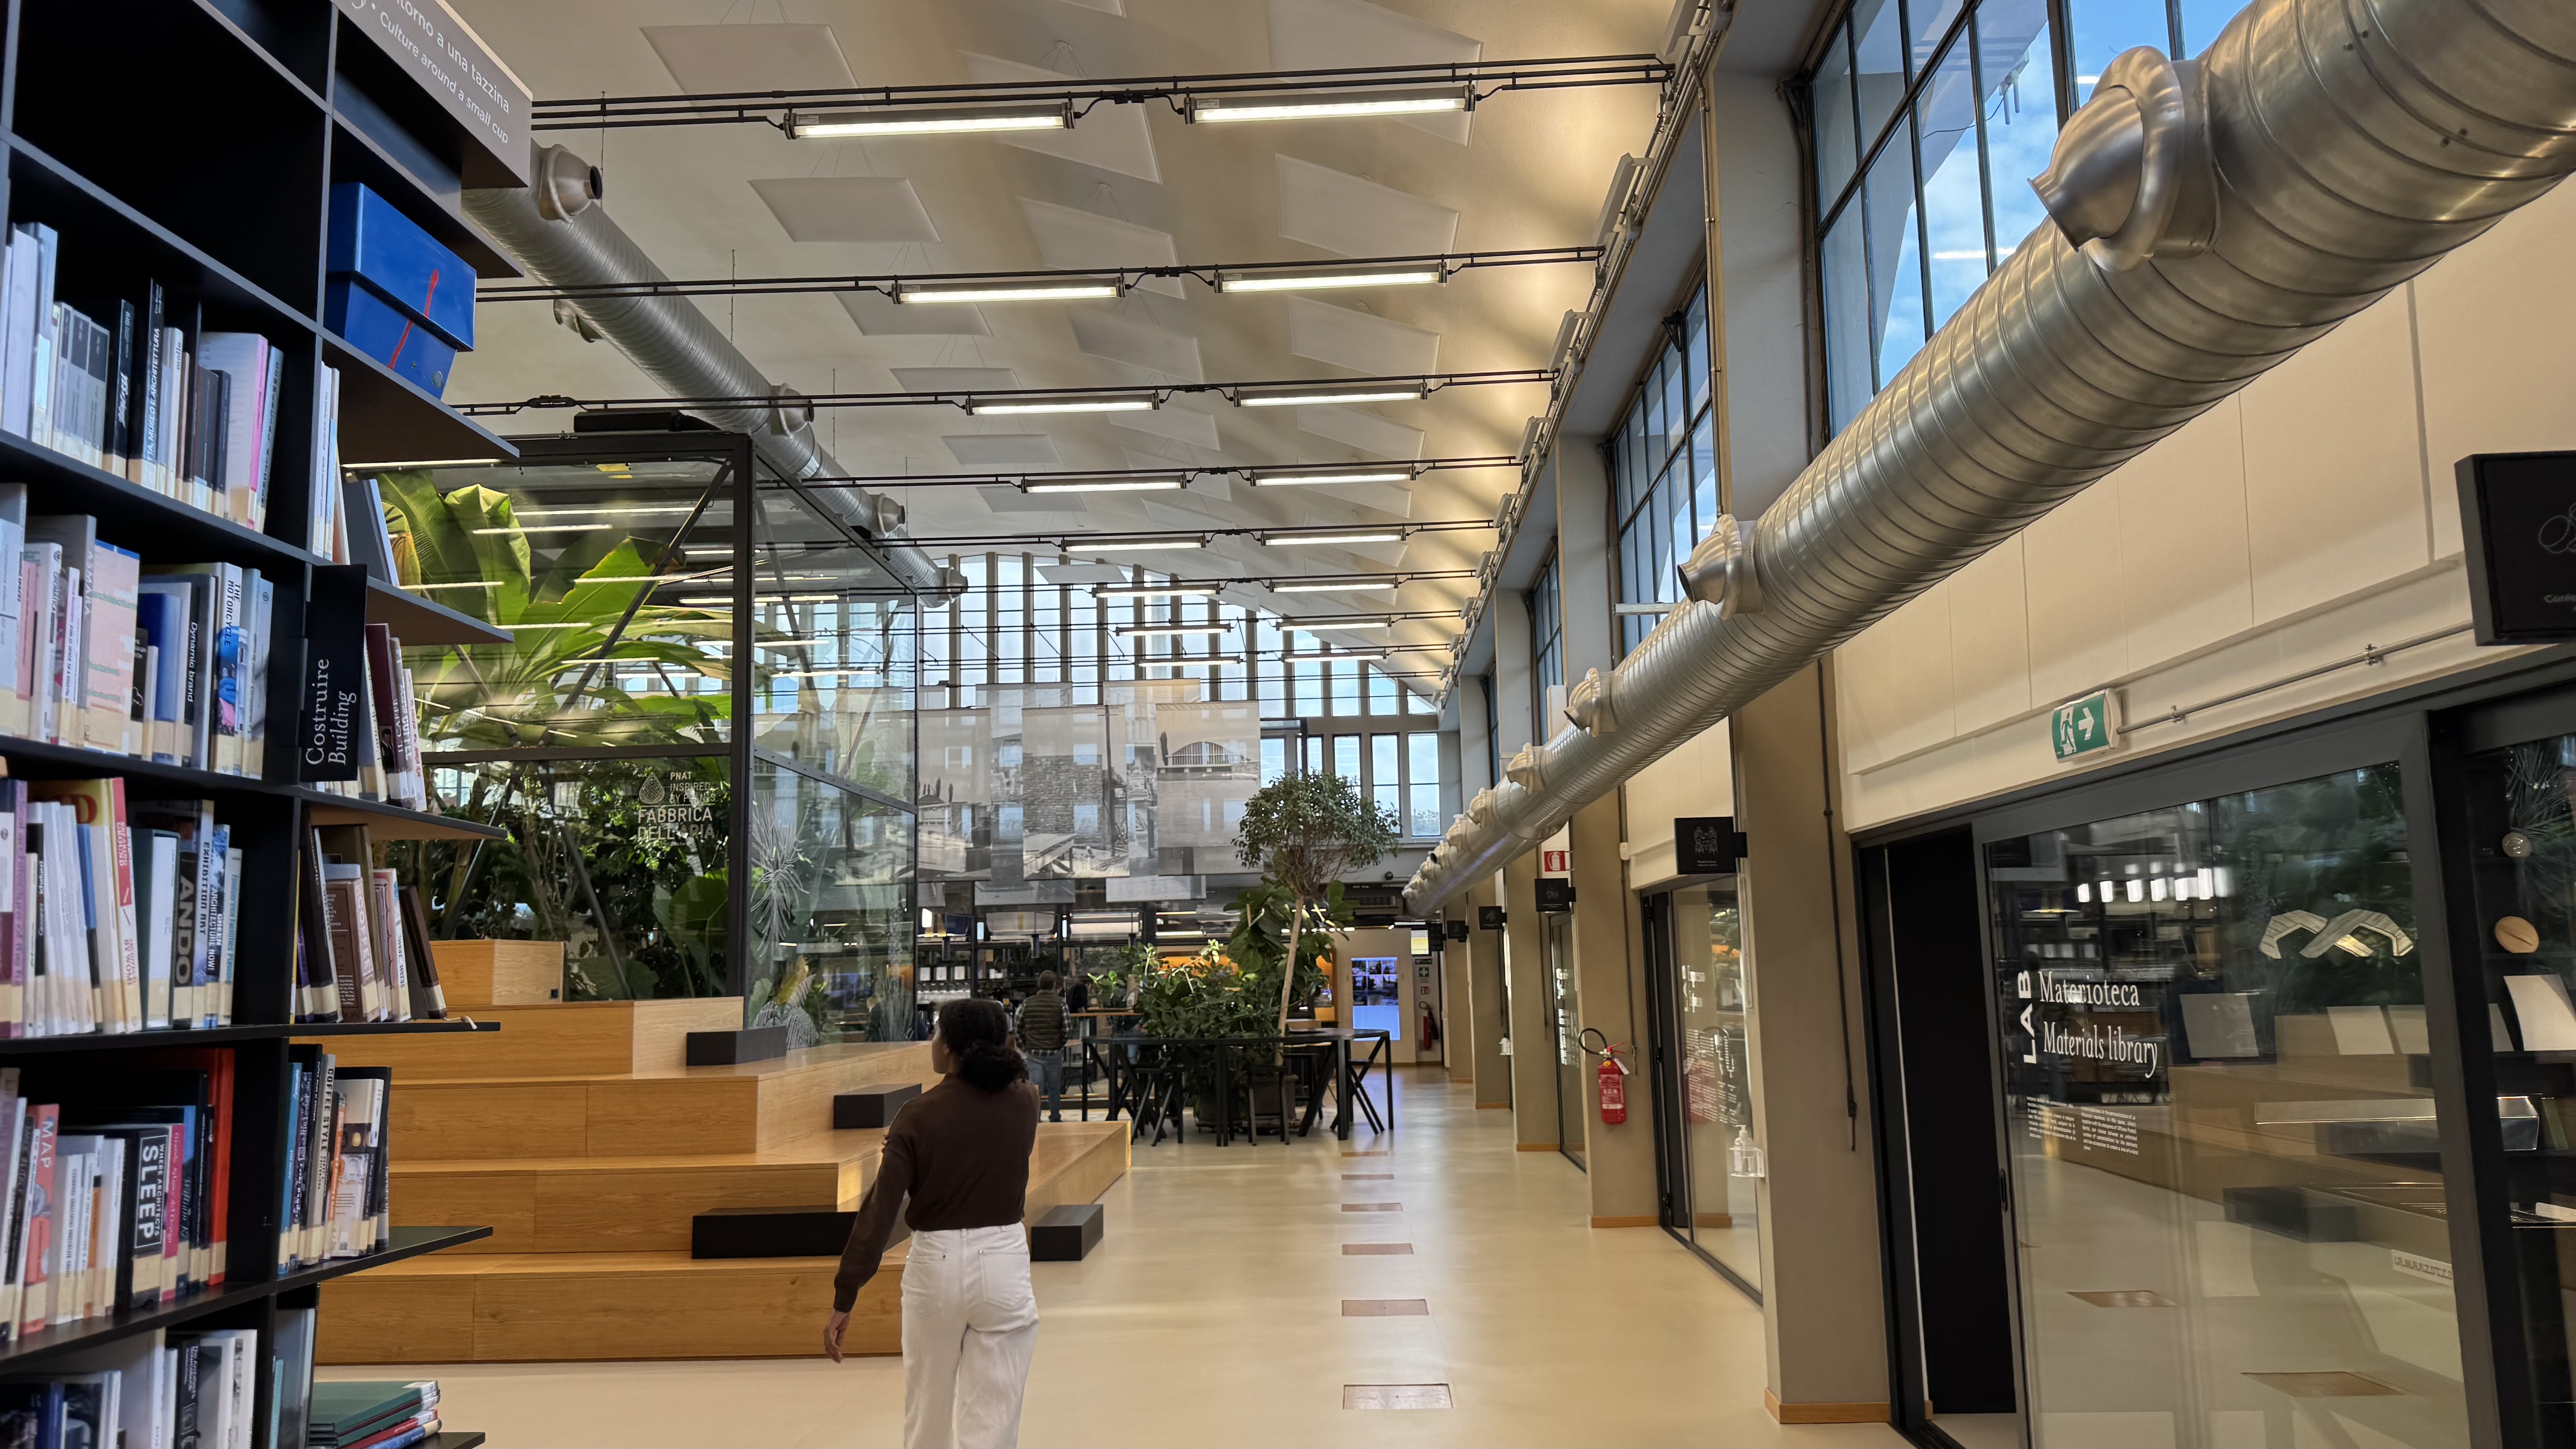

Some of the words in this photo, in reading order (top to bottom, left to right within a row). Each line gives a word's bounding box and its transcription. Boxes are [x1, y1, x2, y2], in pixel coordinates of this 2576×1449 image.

[380, 11, 419, 57] Culture
[421, 53, 456, 94] around
[459, 89, 464, 101] a
[466, 98, 491, 127] small
[492, 122, 509, 144] cup
[437, 32, 444, 48] a
[448, 41, 468, 73] una
[472, 64, 510, 114] tazzina
[151, 328, 160, 400] ARCHITETTURA
[188, 622, 198, 667] Dynamic
[224, 580, 235, 648] MOTORCYCLE
[306, 658, 329, 765] Costruire
[328, 690, 357, 765] Building
[670, 772, 692, 780] PNAT
[670, 782, 710, 791] INSPIRED
[638, 807, 713, 823] FABBRICA
[201, 842, 210, 909] EXHIBITION
[176, 875, 194, 984] ANDO
[208, 888, 219, 947] ARCHITECTURE
[358, 896, 373, 970] COFFEE
[2018, 970, 2037, 1064] LAB
[2038, 971, 2140, 1006] Materioteca
[2043, 1021, 2105, 1059] Materials
[2107, 1025, 2158, 1078] library
[322, 1068, 334, 1111] COFFEE
[41, 1120, 55, 1168] MAP
[320, 1116, 330, 1152] STYLE
[138, 1145, 159, 1238] SLEEP
[154, 1178, 163, 1236] ARCHITECTS
